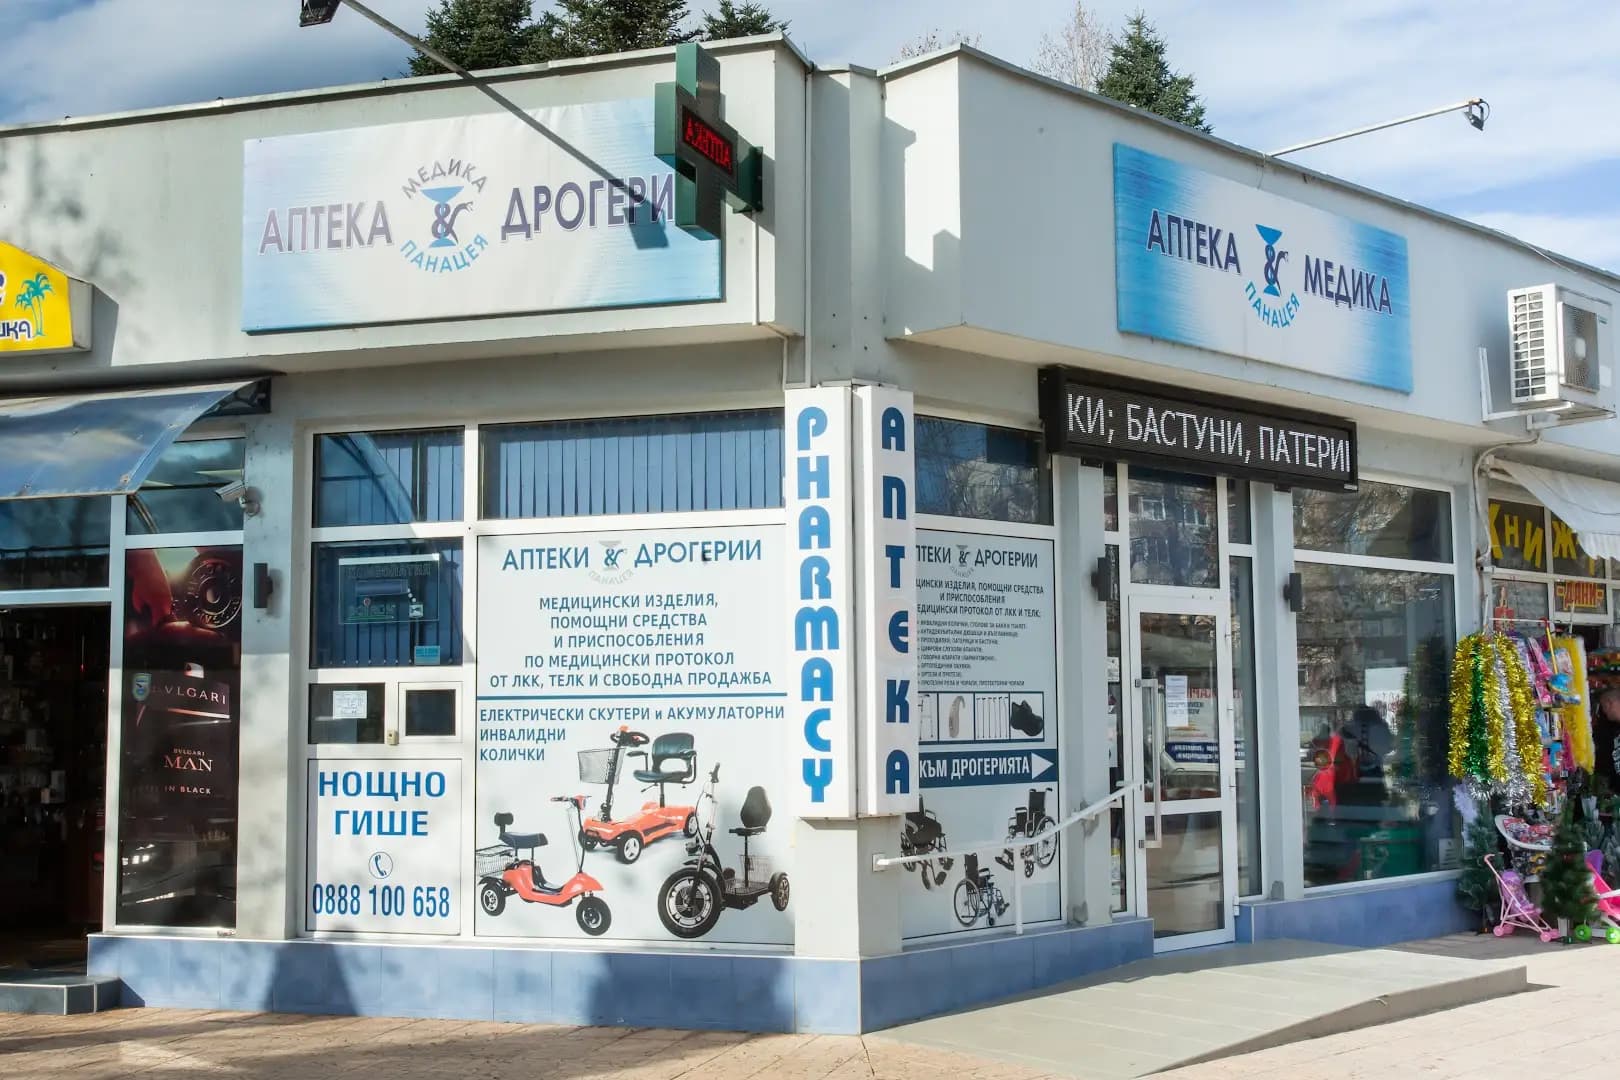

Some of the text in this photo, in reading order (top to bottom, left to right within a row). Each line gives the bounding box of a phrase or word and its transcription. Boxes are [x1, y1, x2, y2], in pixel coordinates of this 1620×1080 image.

[401, 158, 489, 199] МЕДИКА
[258, 200, 394, 256] АПТЕКА
[400, 233, 489, 274] ПАНАЦЕЯ
[1146, 208, 1242, 275] АПТЕКА
[1303, 254, 1393, 315] МЕДИКА
[1244, 280, 1301, 329] ПАНАЦЕЯ
[1126, 402, 1251, 464] БАСТУНИ,
[502, 546, 589, 571] АПТЕКИ
[634, 539, 762, 569] ДРОГЕРИИ
[974, 549, 1038, 568] ДРОГЕРИИ
[881, 406, 912, 795] АПТЕКА
[978, 582, 1012, 593] ПОМОЩНИ
[1013, 584, 1044, 595] СРЕДСТВА
[539, 593, 719, 612] МЕДИЦИНСКИ ИЗДЕЛИЯ,
[794, 406, 840, 803] PHARMACY
[960, 605, 994, 616] ПРОТОКОЛ
[550, 613, 707, 631] ПОМОЩНИ СРЕДСТВА
[554, 633, 704, 648] И ПРИСПОСОБЛЕНИЯ
[524, 652, 735, 670] ПО МЕДИЦИНСКИ ПРОТОКОЛ
[489, 671, 773, 690] ОТ ЛКК, ТЕЛК И СВОБОДНА ПРОДАЖБА
[480, 707, 584, 722] ЕЛЕКТРИЧЕСКИ
[589, 706, 651, 721] СКУТЕРИ
[667, 705, 785, 720] АКУМУЛАТОРНИ
[480, 728, 567, 743] ИНВАЛИДНИ
[164, 754, 213, 772] MAN
[480, 748, 546, 761] КОЛИЧКИ
[919, 756, 1030, 781] КЪМ ДРОГЕРИЯТА
[180, 785, 211, 795] BLACK
[319, 771, 446, 801] НОЩНО
[335, 810, 429, 836] ГИШЕ
[312, 883, 450, 918] 0888 100 658
